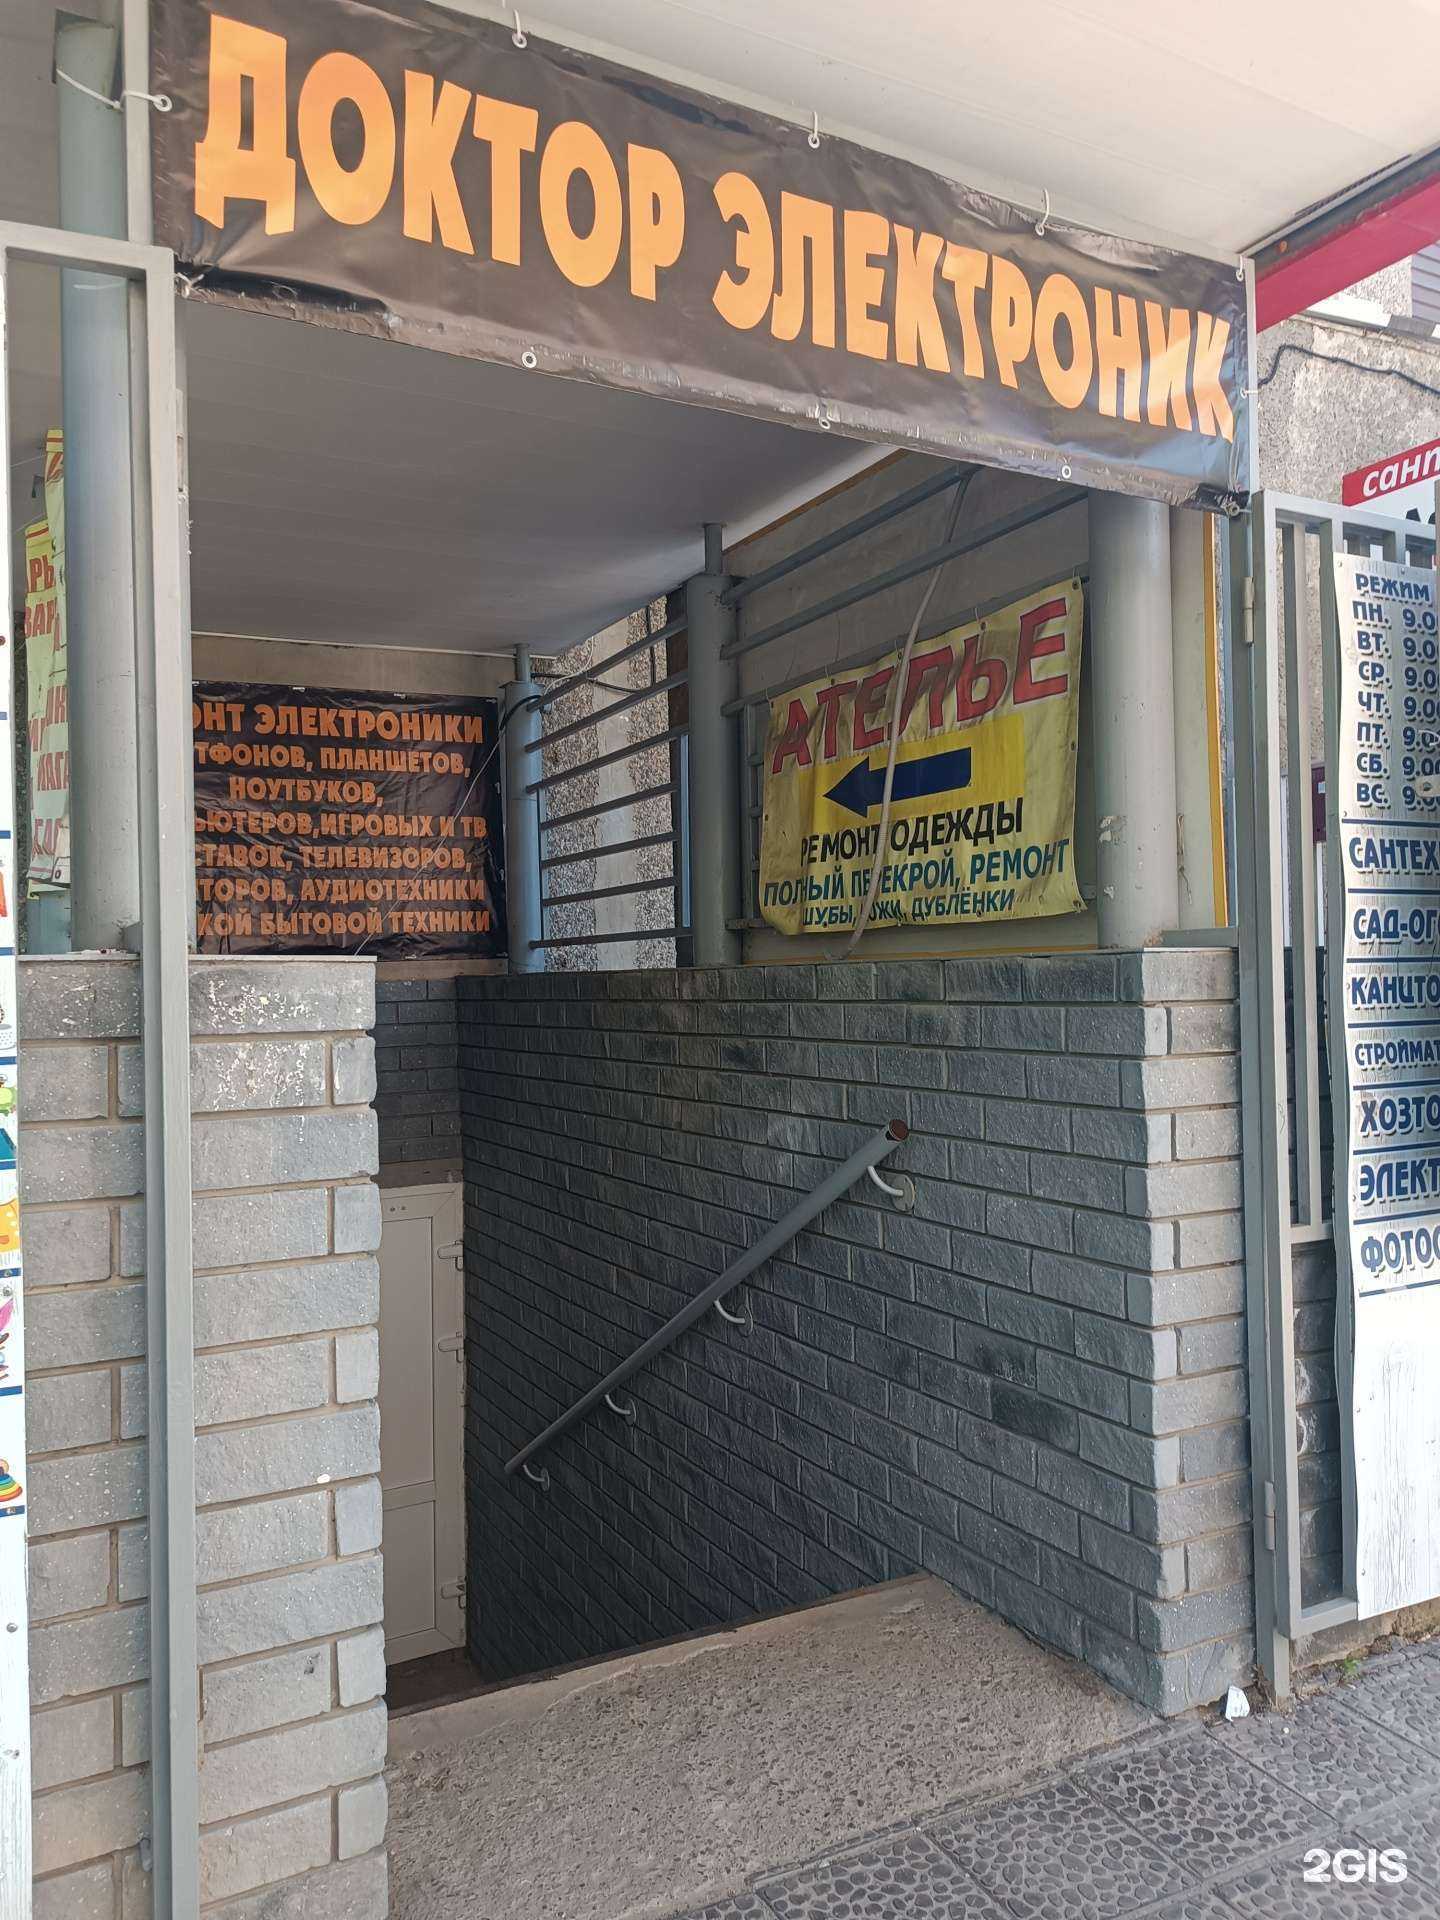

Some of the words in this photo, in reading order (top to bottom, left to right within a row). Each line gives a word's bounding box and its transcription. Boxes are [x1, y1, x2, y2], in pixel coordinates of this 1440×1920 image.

[195, 13, 685, 301] ДОКТОР
[713, 172, 1234, 443] ЭЛЕКТРОНИК
[1355, 573, 1430, 601] РЕЖИМ
[1353, 600, 1389, 624] ПН.
[1402, 608, 1440, 630] 9.0
[1357, 631, 1389, 653] ВТ.
[1403, 637, 1440, 659] 9.0
[772, 597, 1068, 774] АТЕЛЬЕ
[1359, 661, 1390, 683] СР.
[1404, 666, 1440, 689] 9.0
[1358, 691, 1389, 713] ЧТ.
[1403, 696, 1440, 718] 9.0
[254, 704, 483, 743] ЭЛЕКТРОНИКИ
[1358, 722, 1388, 744] ПТ.
[195, 742, 313, 772] ТФОНОВ,
[320, 747, 471, 778] ПЛАНШЕТОВ,
[1357, 752, 1388, 773] СБ.
[229, 776, 384, 807] НОУТБУКОВ,
[1357, 783, 1389, 804] ВС.
[440, 816, 455, 837] И
[461, 816, 488, 838] ТВ
[801, 824, 881, 867] РЕМОНТ
[891, 797, 1023, 856] ОДЕЖДЫ
[299, 846, 473, 873] ТЕЛЕВИЗОРОВ,
[1349, 838, 1440, 870] САНТЕХ
[764, 865, 844, 906] ПОЛНЫЙ
[851, 848, 960, 898] ПЕЕКРОЙ,
[970, 839, 1069, 885] РЕМОНТ
[197, 878, 294, 905] ТОРОВ,
[301, 879, 485, 905] АУДИОТЕХНИКИ
[861, 898, 907, 922] ОЖИ,
[911, 886, 1015, 922] ДУБЛЁНКИ
[197, 907, 252, 936] КОЙ
[260, 906, 383, 935] БЫТОВОЙ
[389, 910, 490, 933] ТЕХНИКИ
[1354, 908, 1440, 939] САД-ОГ
[1352, 976, 1440, 1005] КАНЦТО
[1361, 1095, 1440, 1133] ХОЗТО
[1360, 1157, 1440, 1201] ЭЛЕКТ
